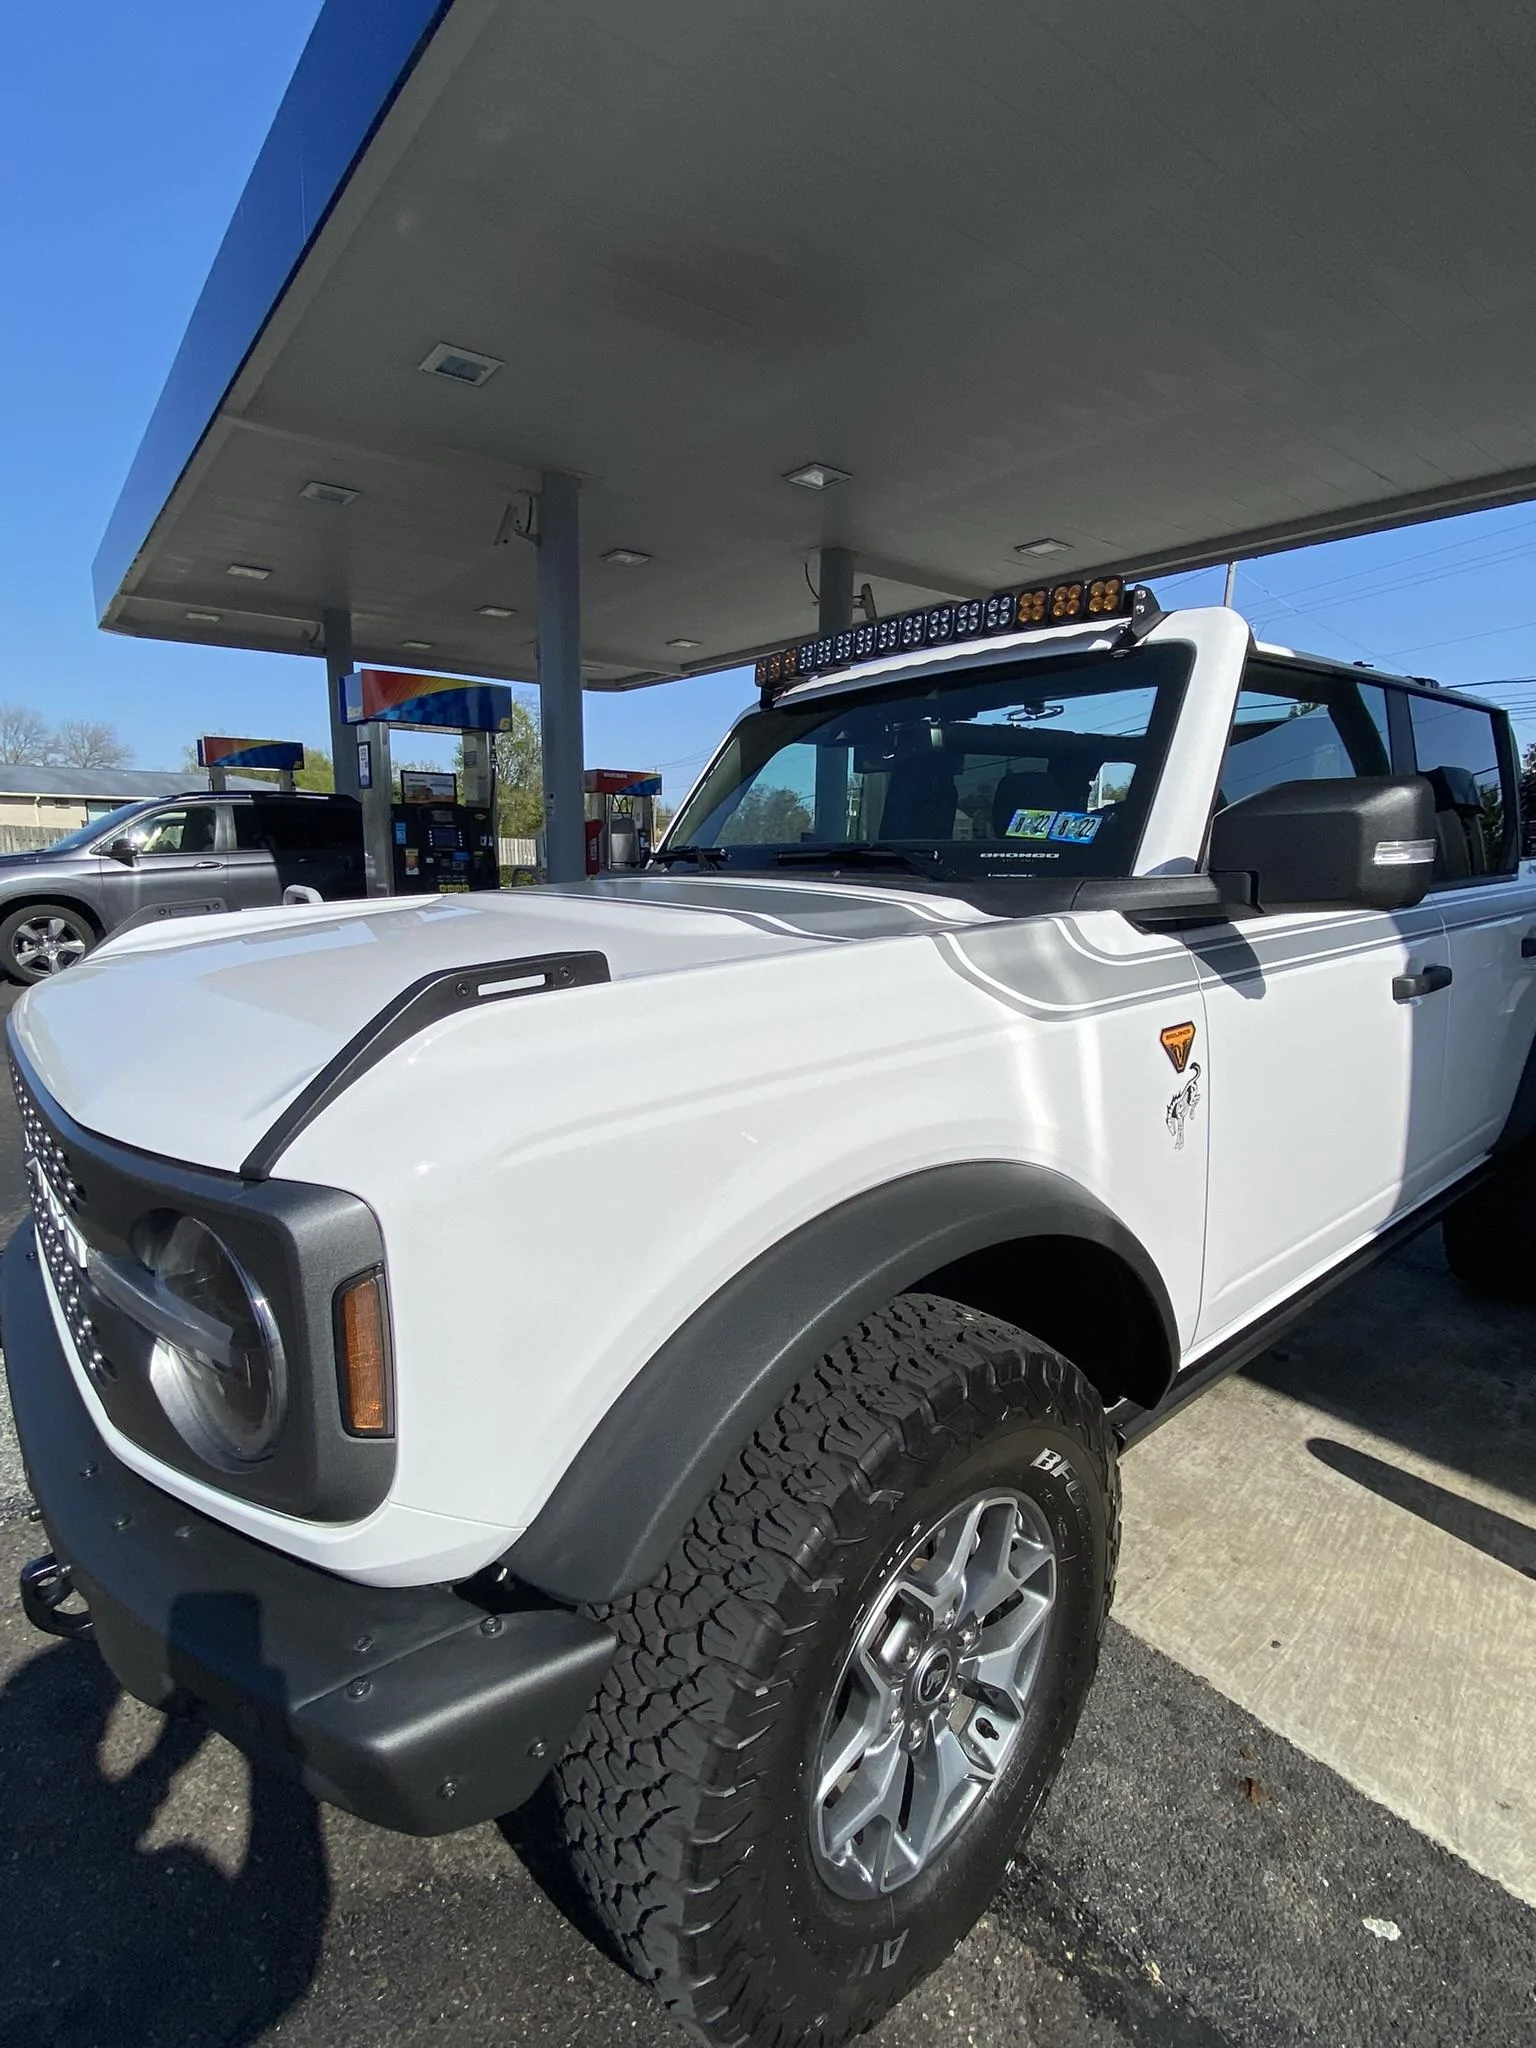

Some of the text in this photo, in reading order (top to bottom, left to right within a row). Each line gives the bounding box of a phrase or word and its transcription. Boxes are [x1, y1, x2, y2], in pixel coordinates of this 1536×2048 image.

[1015, 815, 1050, 833] 8 22
[1058, 818, 1096, 837] 8 22
